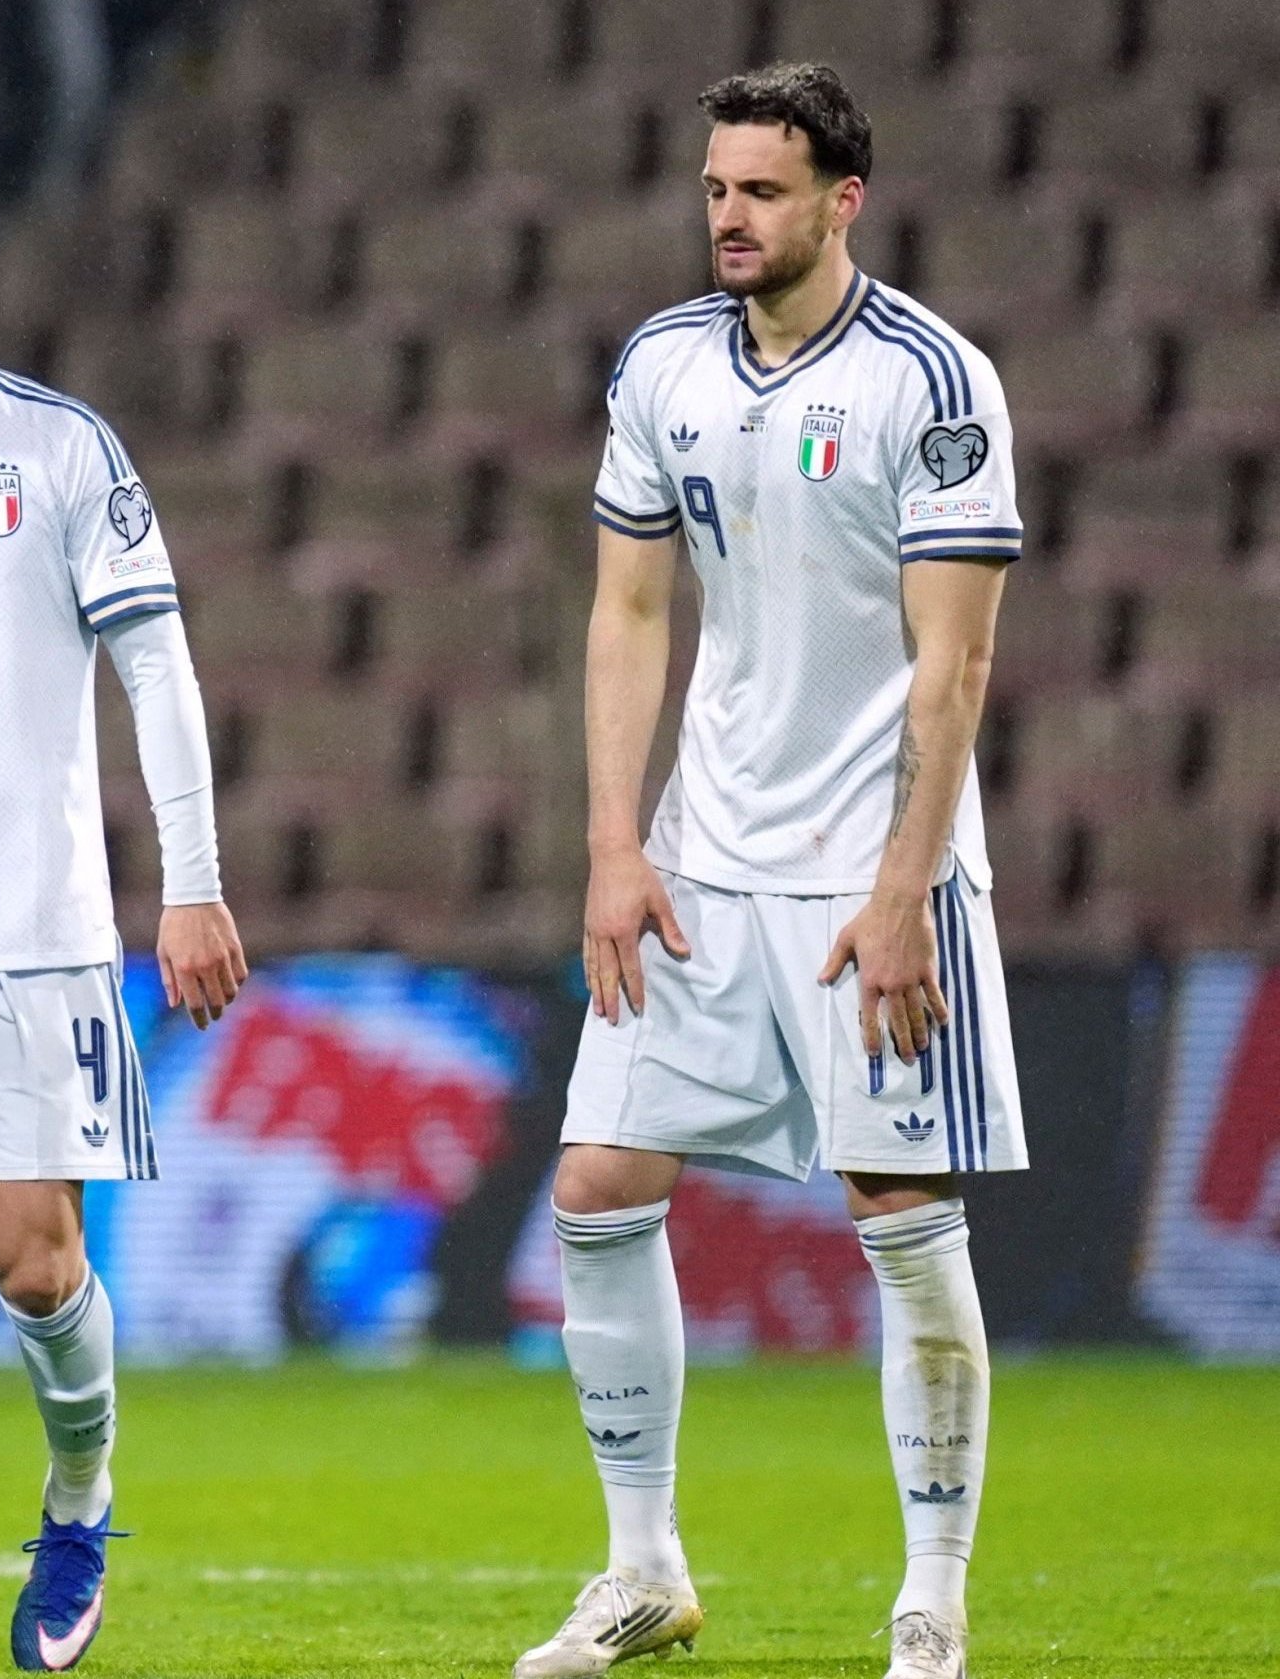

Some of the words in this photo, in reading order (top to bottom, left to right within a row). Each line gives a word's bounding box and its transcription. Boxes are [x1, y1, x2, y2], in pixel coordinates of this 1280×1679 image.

[804, 419, 838, 434] ITALIA
[910, 501, 991, 518] FOUNDATION
[72, 1016, 110, 1106] 4
[578, 1384, 650, 1401] TALIA
[897, 1434, 970, 1448] ITALIA
